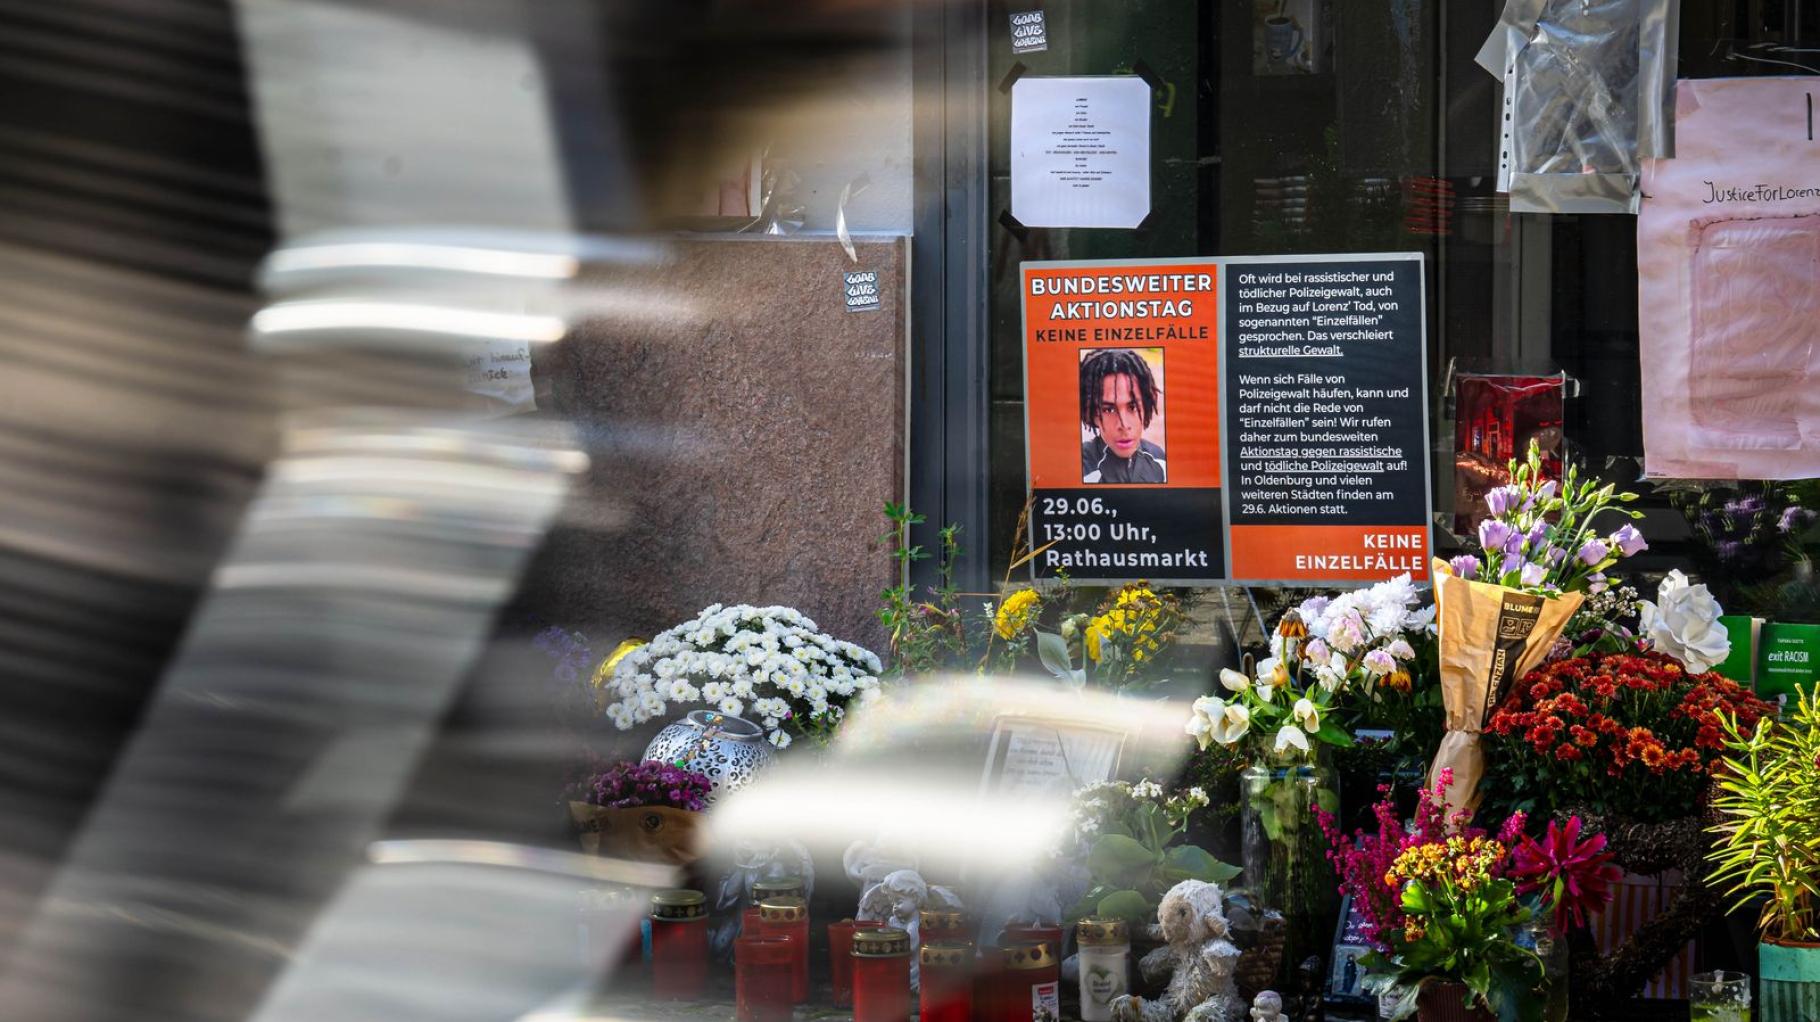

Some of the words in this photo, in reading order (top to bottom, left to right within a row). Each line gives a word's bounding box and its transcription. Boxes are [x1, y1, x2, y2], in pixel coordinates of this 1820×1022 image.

[1031, 274, 1212, 295] BUNDESWEITER
[1239, 273, 1256, 285] Oft
[1258, 273, 1282, 284] wird
[1285, 273, 1301, 283] bei
[1304, 272, 1370, 283] rassistischer
[1372, 271, 1394, 282] und
[1239, 287, 1286, 298] tödlicher
[1289, 287, 1363, 299] Polizeigewalt,
[1366, 286, 1392, 296] auch
[1050, 300, 1192, 320] AKTIONSTAG
[1239, 303, 1253, 313] im
[1256, 303, 1290, 314] Bezug
[1292, 302, 1311, 312] auf
[1353, 300, 1376, 312] Tod,
[1378, 301, 1398, 311] von
[1239, 317, 1310, 329] sogenannten
[1036, 328, 1087, 342] KEINE
[1095, 324, 1209, 341] EINZELFÄLLE
[1239, 331, 1305, 344] gesprochen.
[1307, 330, 1328, 341] Das
[1330, 329, 1394, 340] verschleiert
[1238, 345, 1301, 358] strukturelle
[1302, 345, 1344, 357] Gewalt.
[1239, 374, 1271, 385] Wenn
[1273, 374, 1294, 384] sich
[1297, 373, 1323, 384] Fälle
[1325, 375, 1345, 384] von
[1239, 388, 1311, 401] Polizeigewalt
[1313, 387, 1354, 399] häufen,
[1356, 388, 1384, 398] kann
[1386, 387, 1409, 398] und
[1239, 402, 1261, 414] darf
[1263, 402, 1291, 413] nicht
[1293, 402, 1311, 413] die
[1313, 402, 1341, 413] Rede
[1343, 403, 1364, 413] von
[1311, 417, 1338, 428] sein!
[1340, 417, 1360, 428] Wir
[1362, 416, 1391, 428] rufen
[1240, 432, 1271, 442] daher
[1274, 433, 1298, 442] zum
[1300, 431, 1378, 442] bundesweiten
[1240, 446, 1298, 459] Aktionstag
[1301, 448, 1336, 458] gegen
[1339, 446, 1402, 458] rassistische
[1241, 461, 1262, 471] und
[1265, 461, 1309, 473] tödliche
[1311, 460, 1384, 473] Polizeigewalt
[1387, 460, 1408, 471] auf!
[1241, 475, 1252, 486] In
[1254, 475, 1312, 487] Oldenburg
[1315, 475, 1337, 486] und
[1339, 474, 1372, 486] vielen
[1241, 490, 1288, 500] weiteren
[1291, 489, 1333, 500] Städten
[1336, 489, 1373, 500] finden
[1375, 491, 1394, 500] am
[1043, 498, 1118, 517] 29.06.,
[1242, 504, 1266, 514] 29.6.
[1268, 503, 1317, 514] Aktionen
[1320, 503, 1348, 514] statt.
[1044, 524, 1100, 541] 13:00
[1110, 523, 1156, 543] Uhr,
[1364, 534, 1422, 548] KEINE
[1046, 549, 1208, 567] Rathausmarkt
[1295, 552, 1422, 570] EINZELFÄLLE
